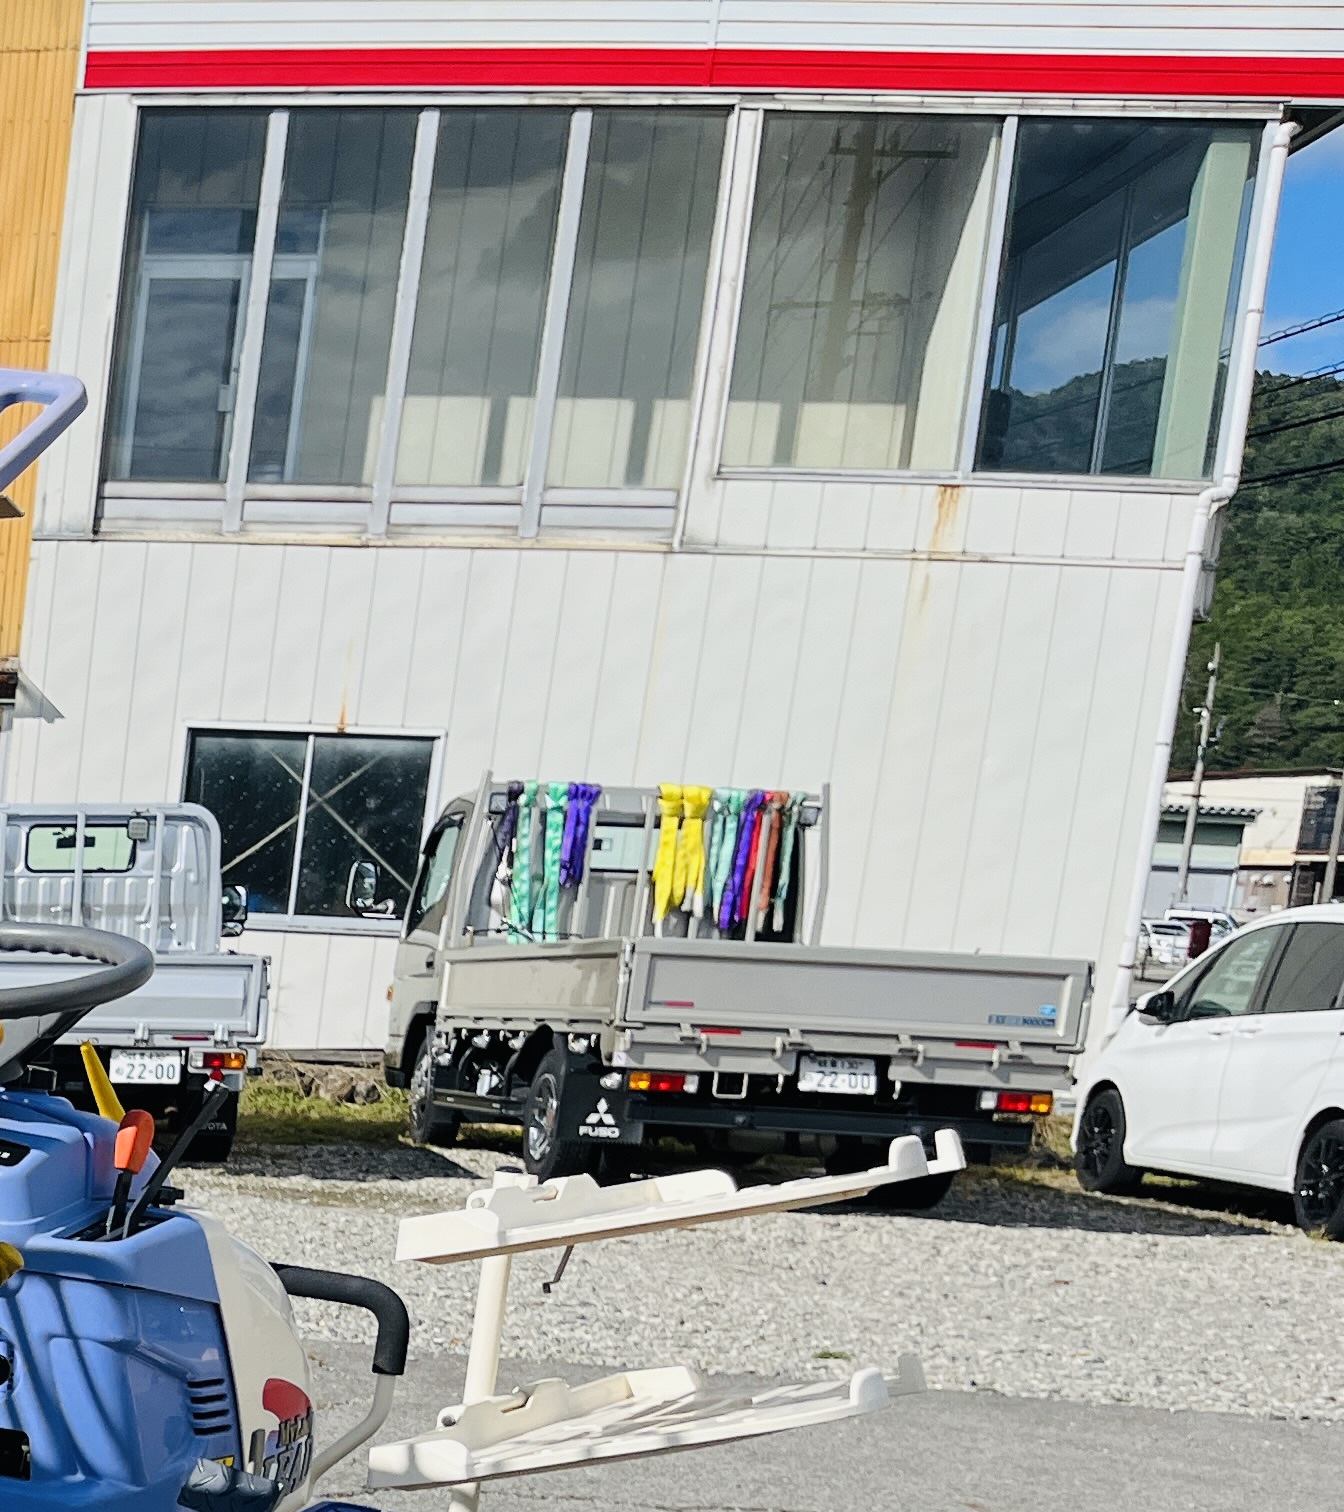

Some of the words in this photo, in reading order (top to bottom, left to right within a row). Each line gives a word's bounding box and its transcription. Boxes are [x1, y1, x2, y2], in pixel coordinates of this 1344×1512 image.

[127, 1063, 175, 1080] 22-00
[816, 1069, 871, 1090] 22-00
[579, 1125, 620, 1139] FUSO
